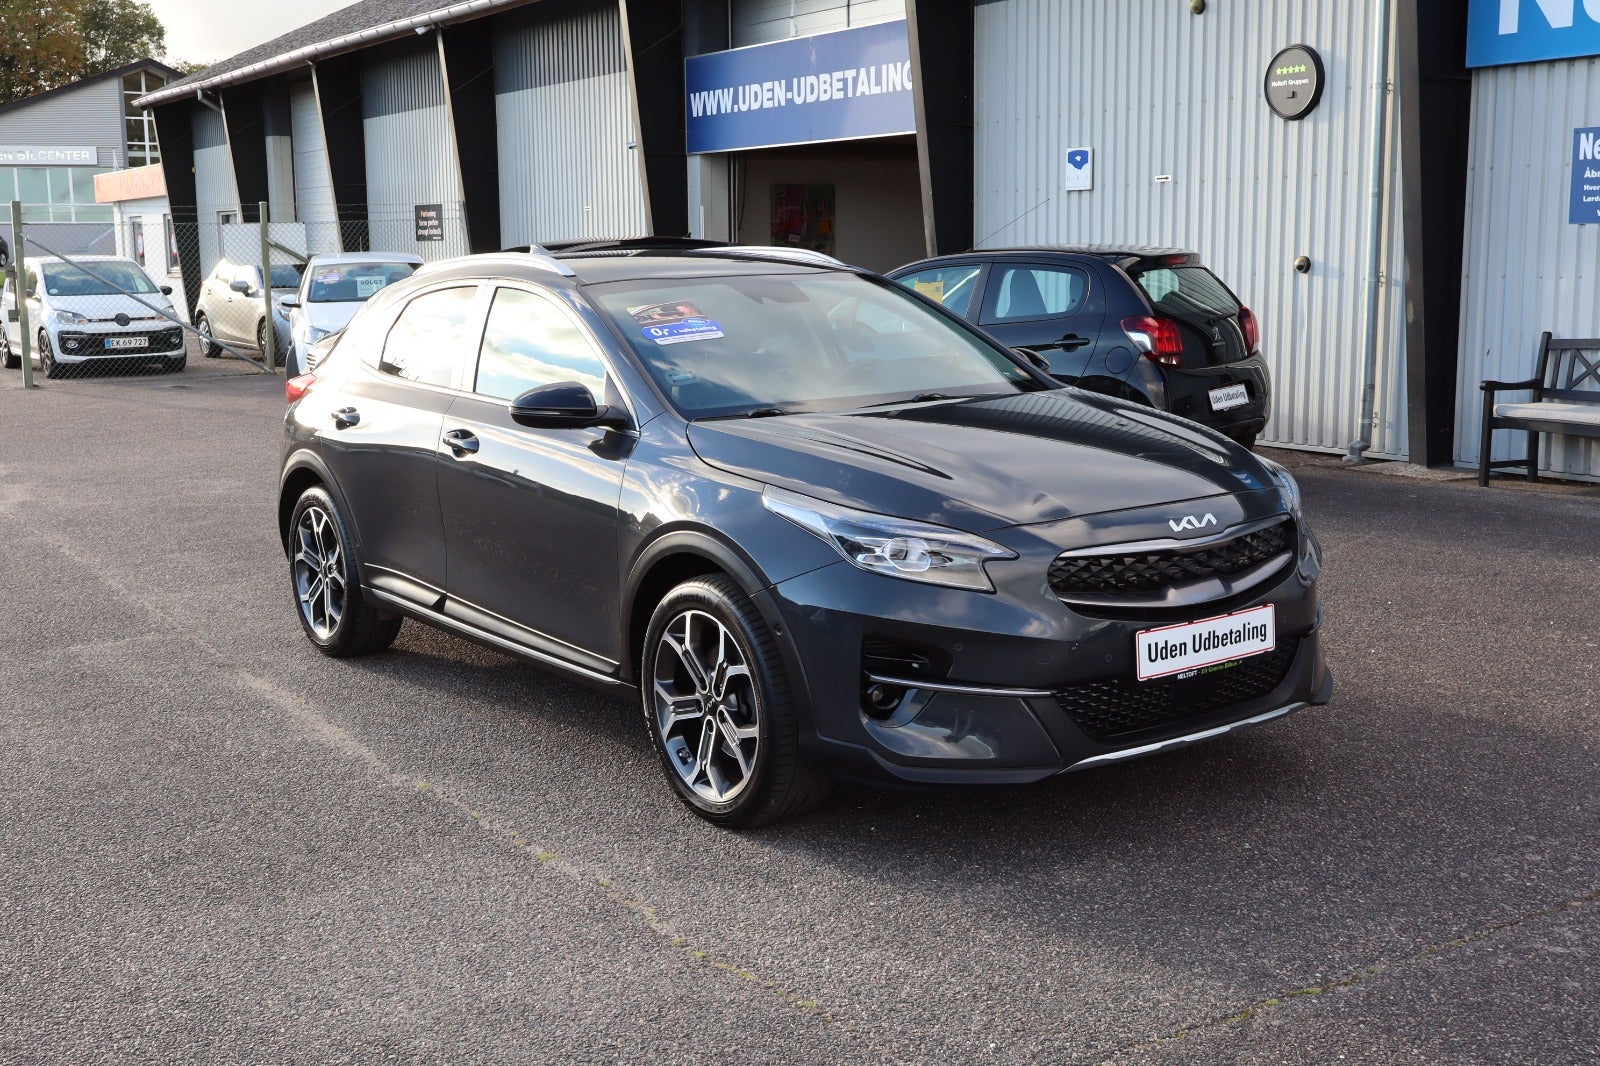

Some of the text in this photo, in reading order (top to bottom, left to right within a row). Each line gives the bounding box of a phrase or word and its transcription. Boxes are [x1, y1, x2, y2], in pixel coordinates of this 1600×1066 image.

[133, 338, 147, 346] 727
[1147, 622, 1267, 663] Uden Udbetaling
